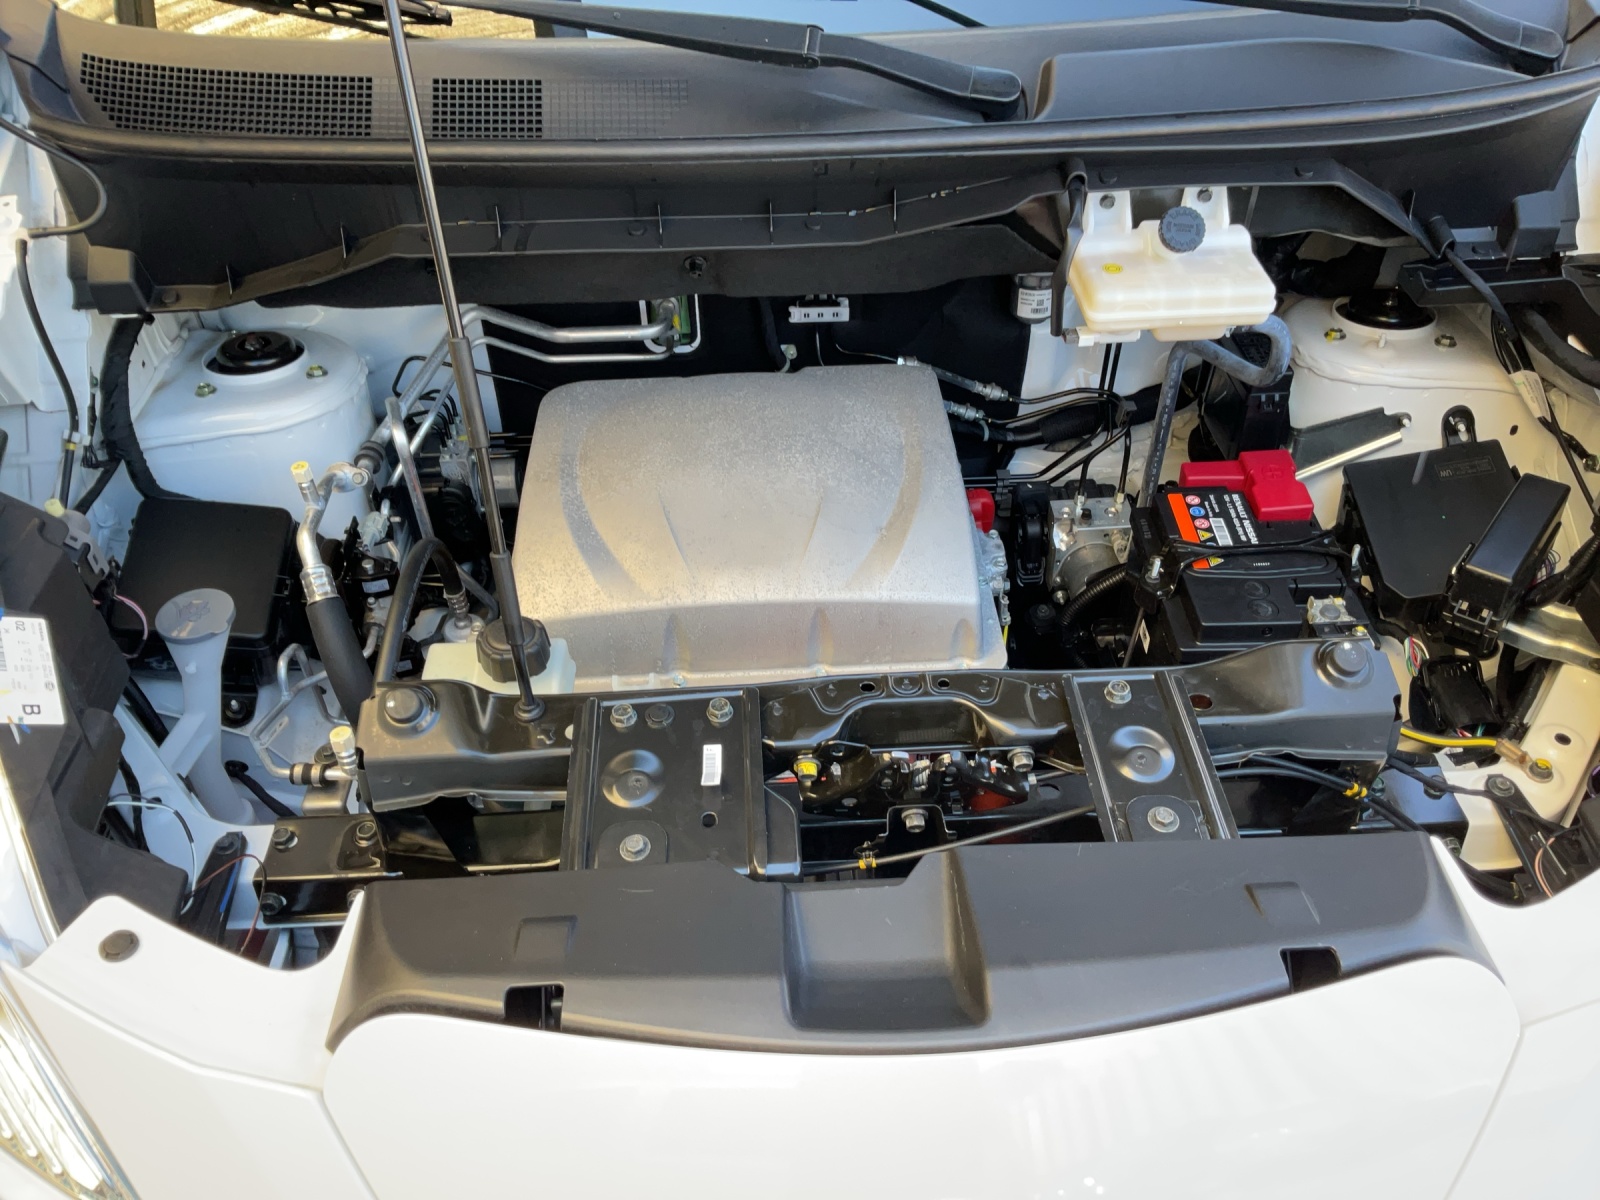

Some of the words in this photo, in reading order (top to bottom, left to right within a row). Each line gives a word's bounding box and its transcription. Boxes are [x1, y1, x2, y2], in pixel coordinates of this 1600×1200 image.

[1231, 494, 1248, 519] RENAULT
[15, 621, 25, 631] 02
[22, 704, 41, 716] B
